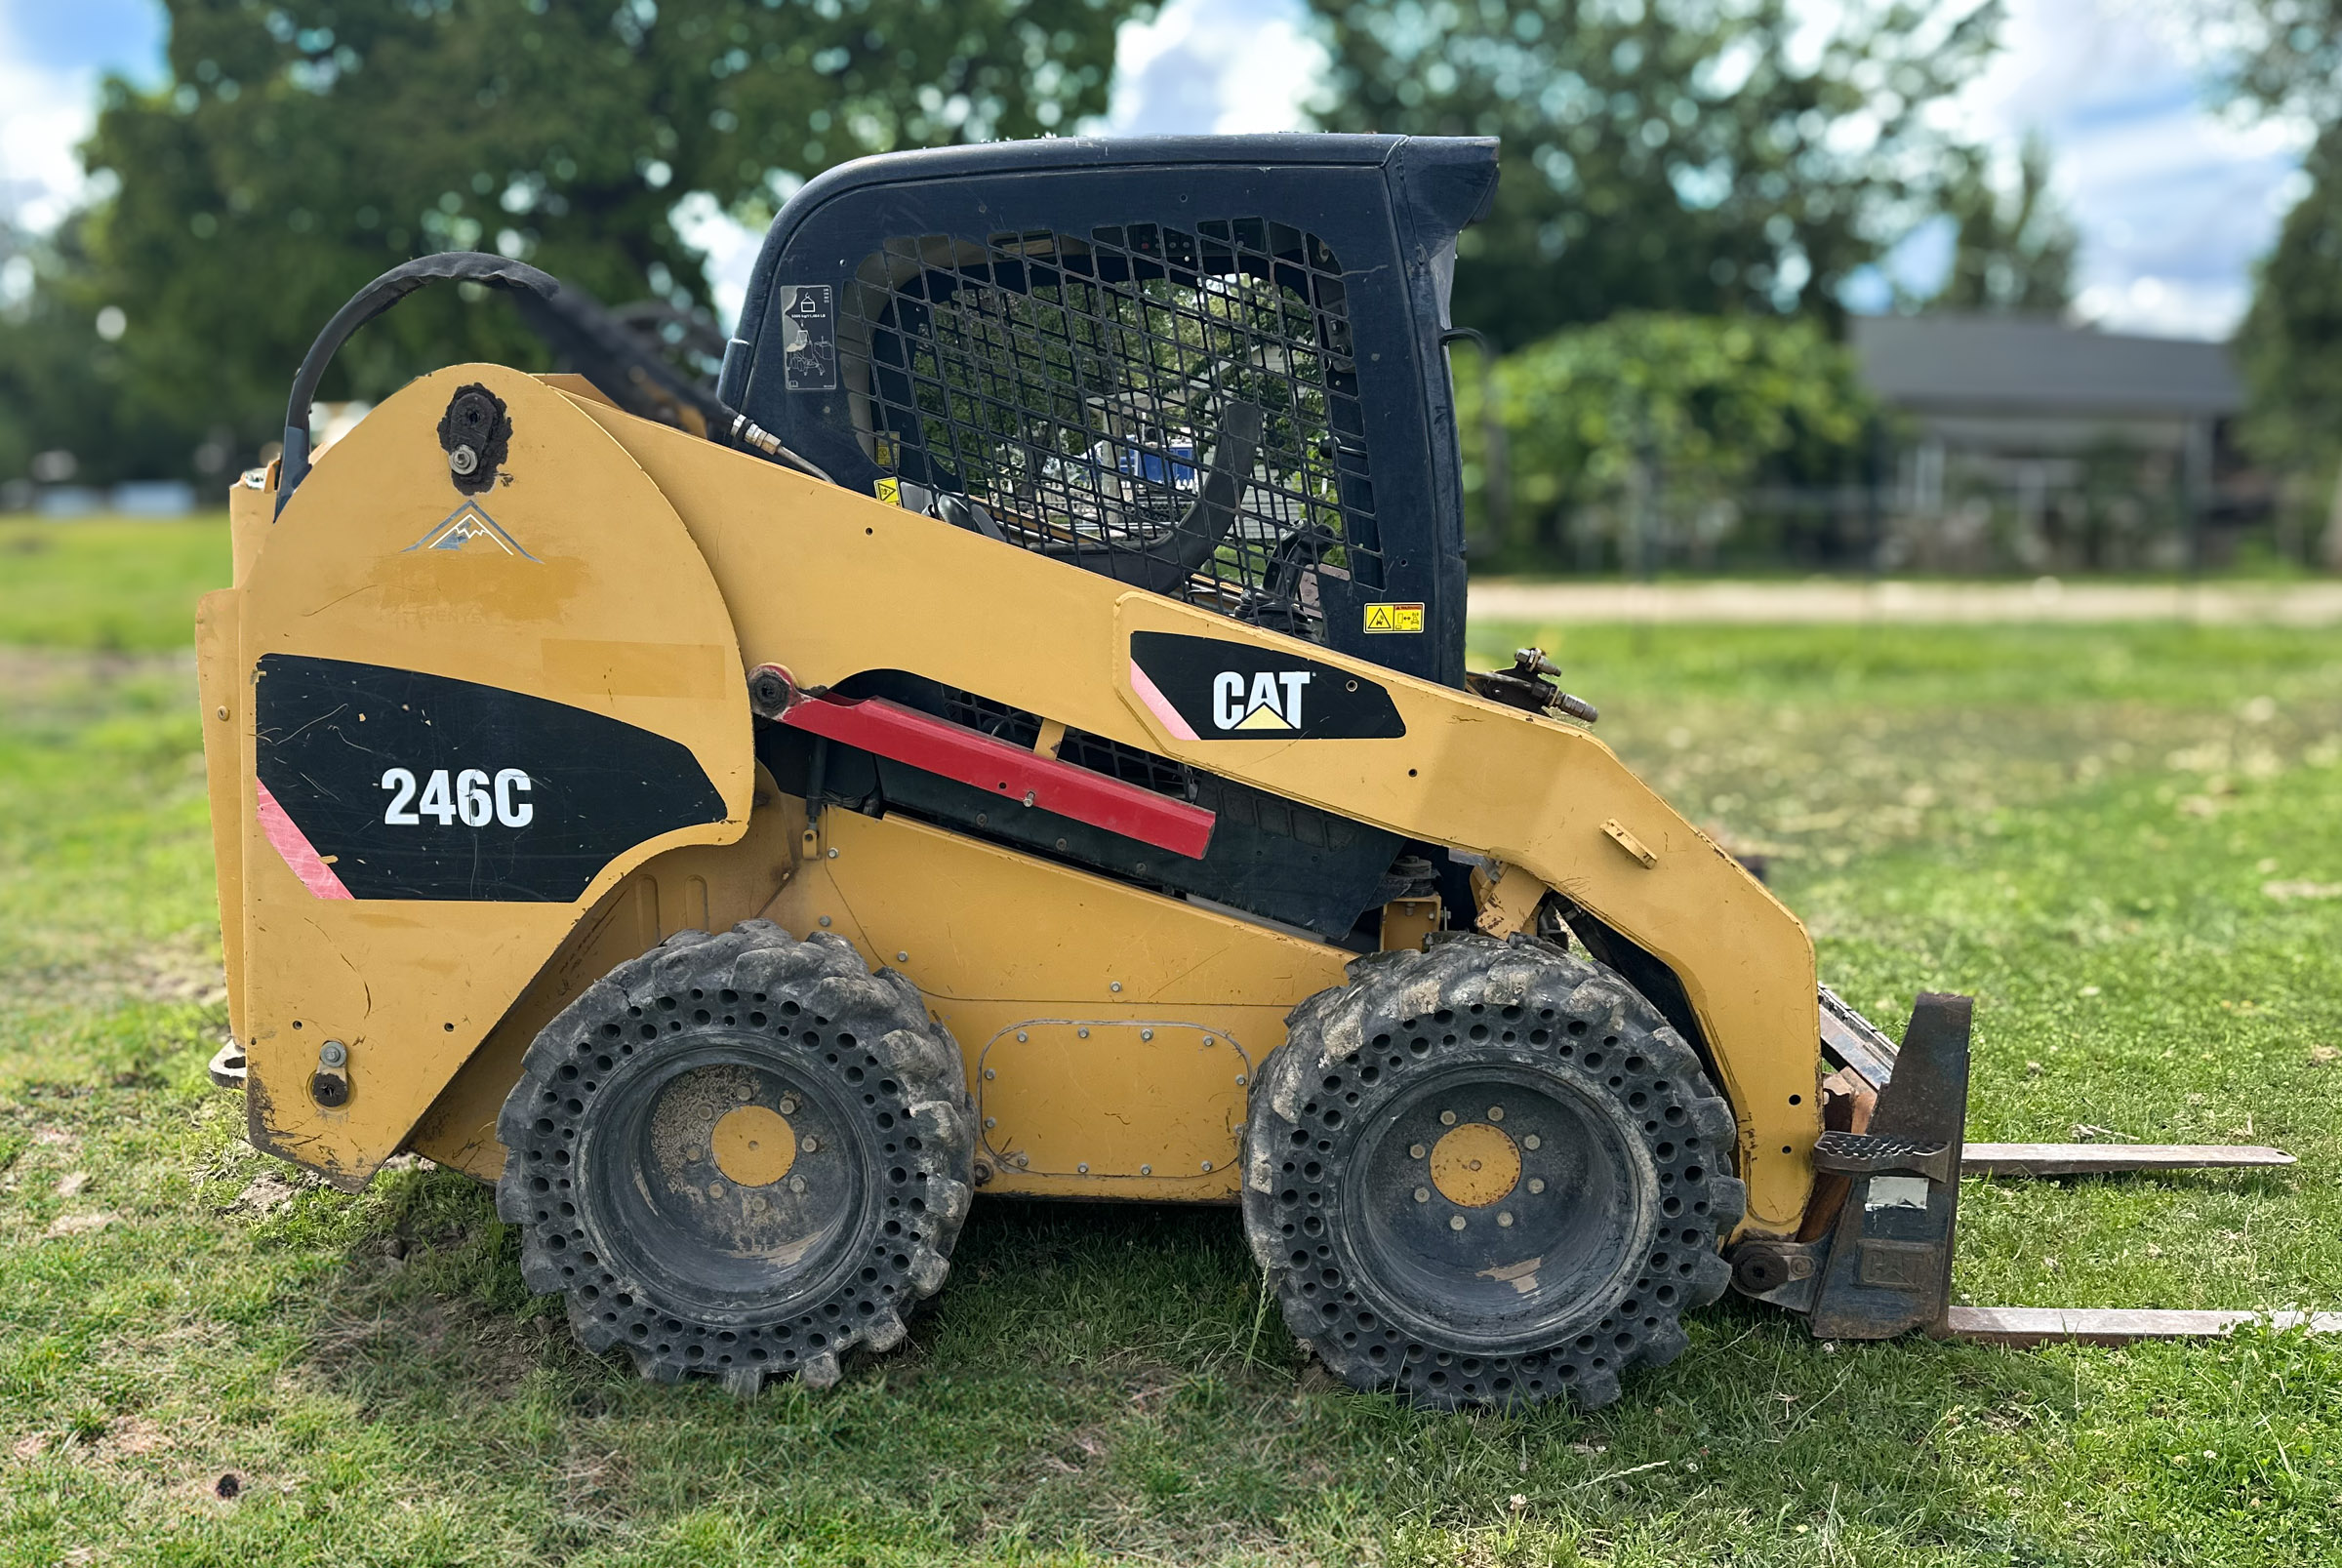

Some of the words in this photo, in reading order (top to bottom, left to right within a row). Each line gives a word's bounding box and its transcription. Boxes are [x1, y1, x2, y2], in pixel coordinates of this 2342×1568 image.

[1213, 671, 1311, 730] CAT
[382, 768, 534, 827] 246C
[1863, 1250, 1924, 1285] CAT
